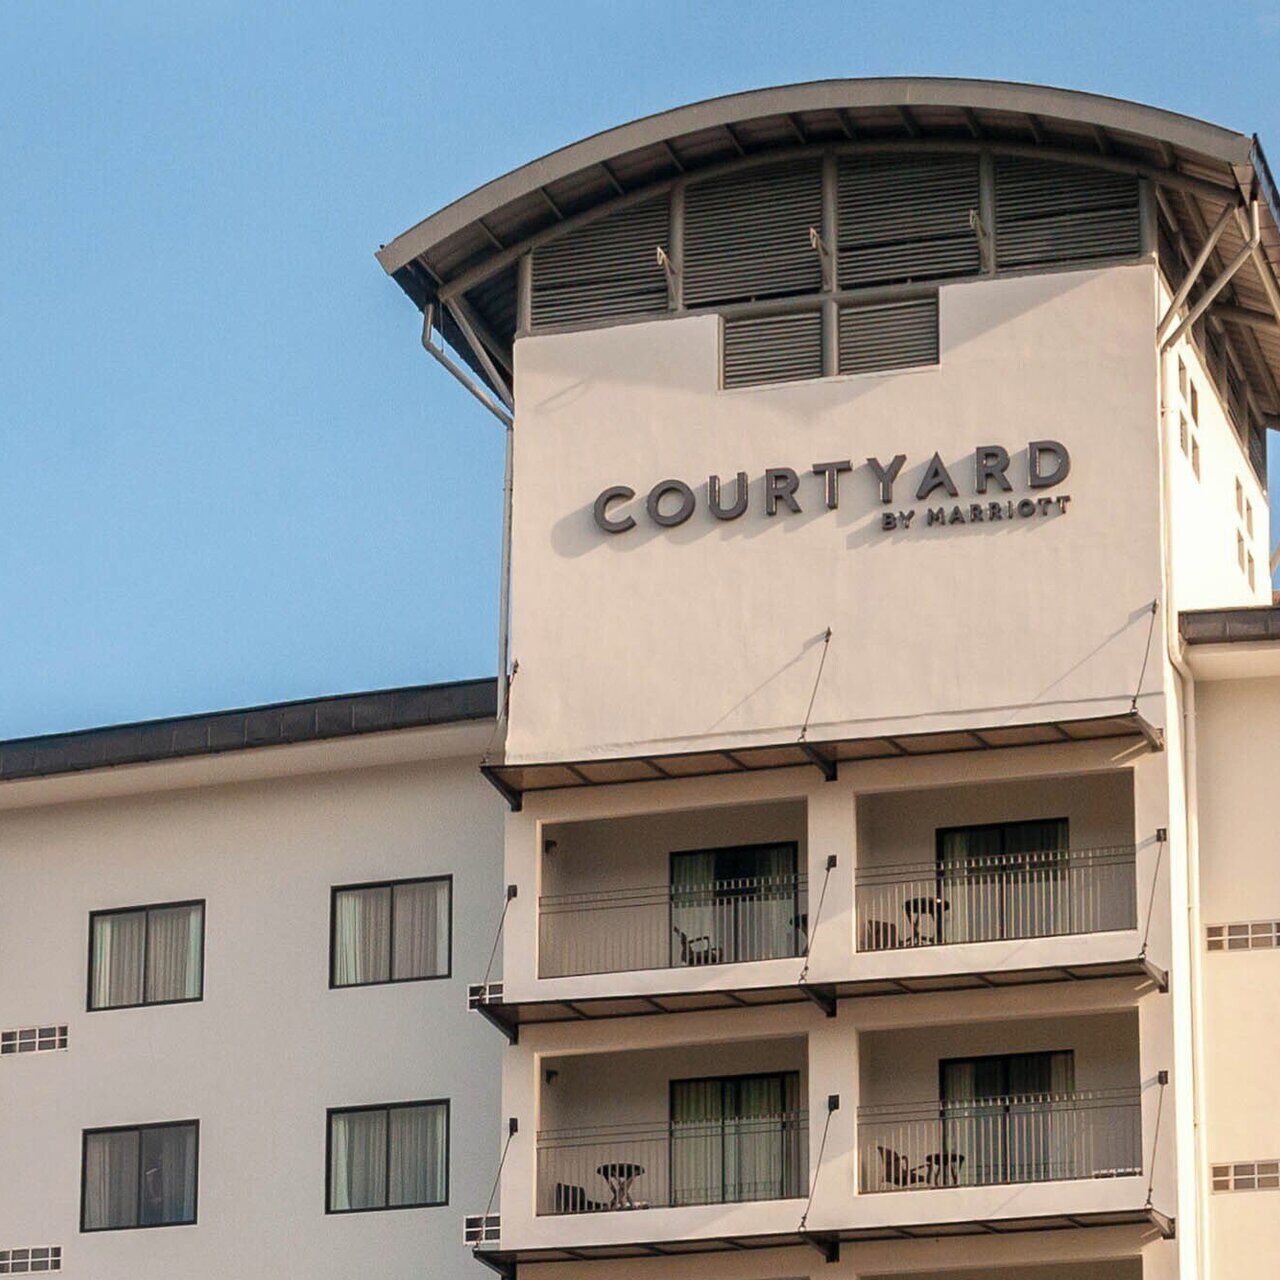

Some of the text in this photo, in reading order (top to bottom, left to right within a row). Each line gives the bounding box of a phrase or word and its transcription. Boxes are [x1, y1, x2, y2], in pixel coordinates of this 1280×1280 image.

[593, 440, 1072, 534] COURTYARD
[881, 495, 1072, 532] BY MARRIOTT
